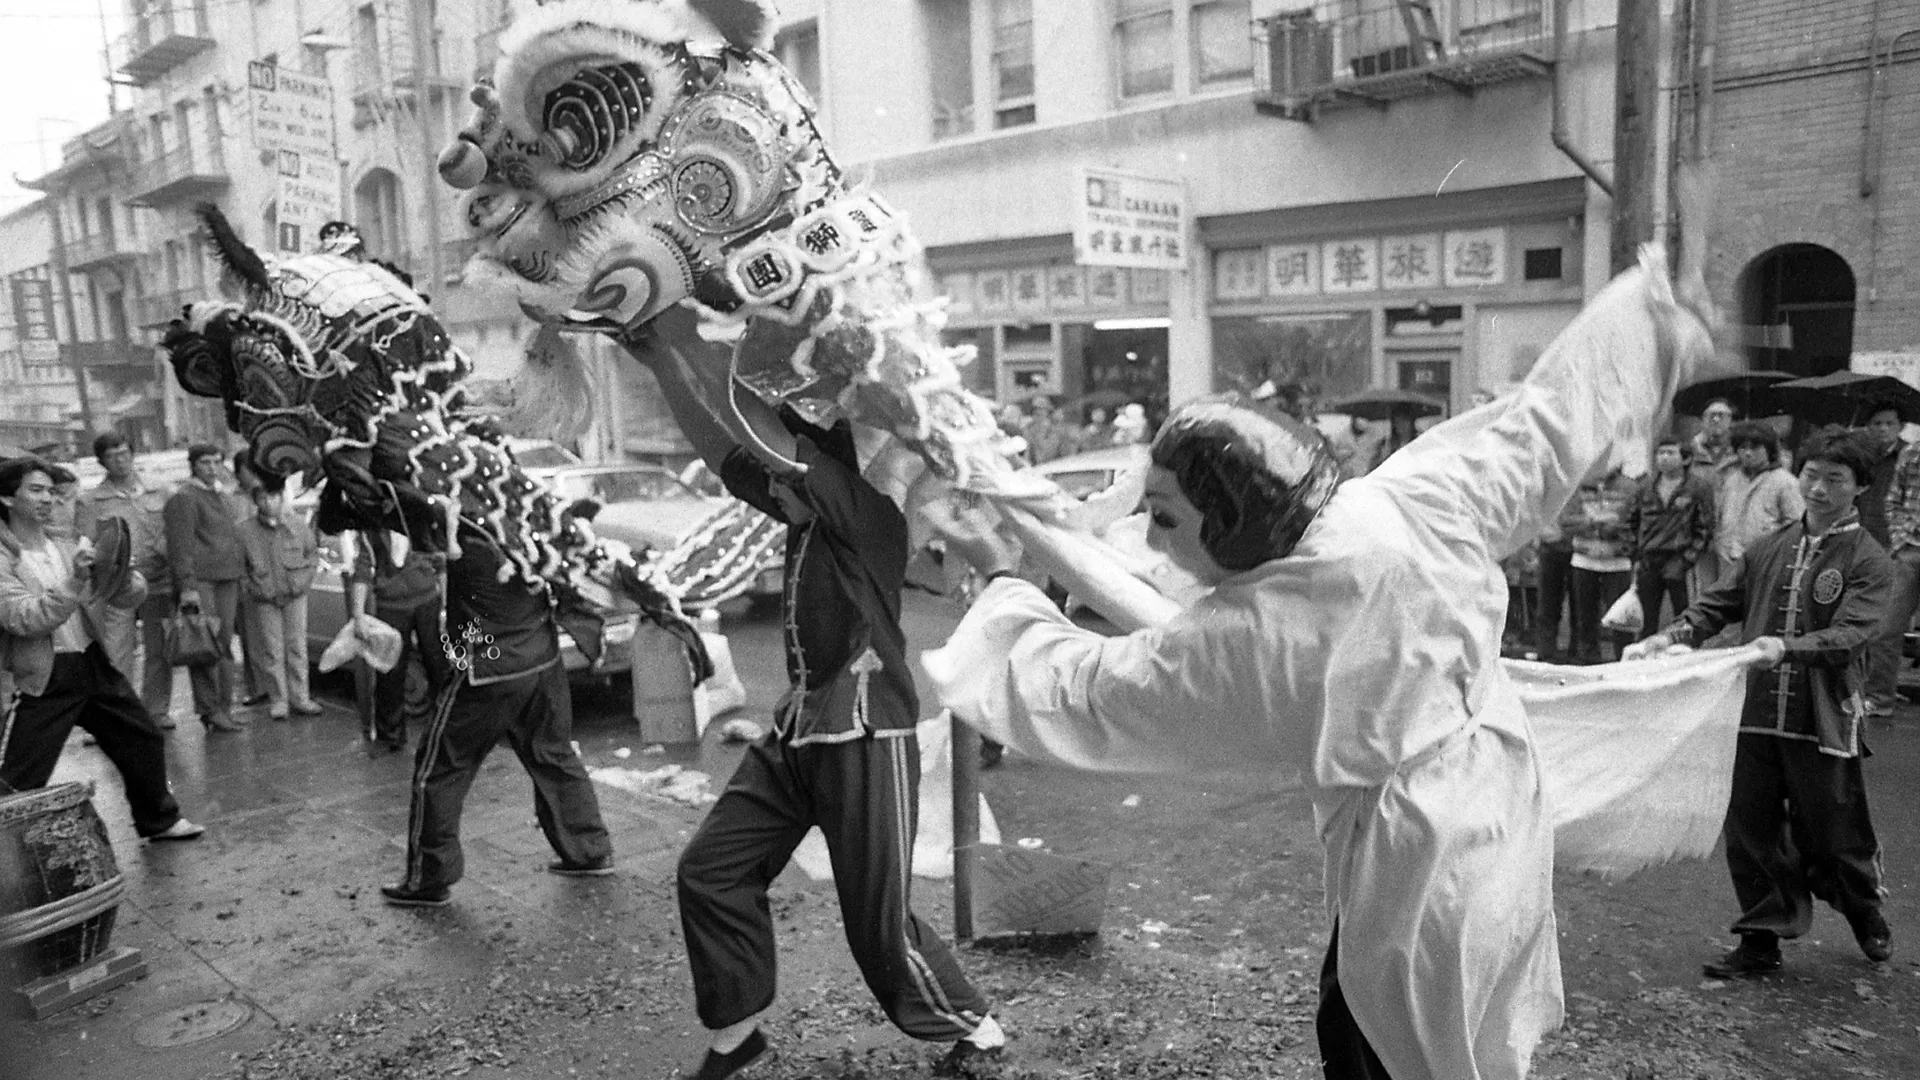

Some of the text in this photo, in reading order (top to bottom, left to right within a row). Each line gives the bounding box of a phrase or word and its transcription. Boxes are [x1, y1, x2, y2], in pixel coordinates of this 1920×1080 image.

[250, 62, 327, 100] NO PARKING
[982, 851, 1034, 883] NO
